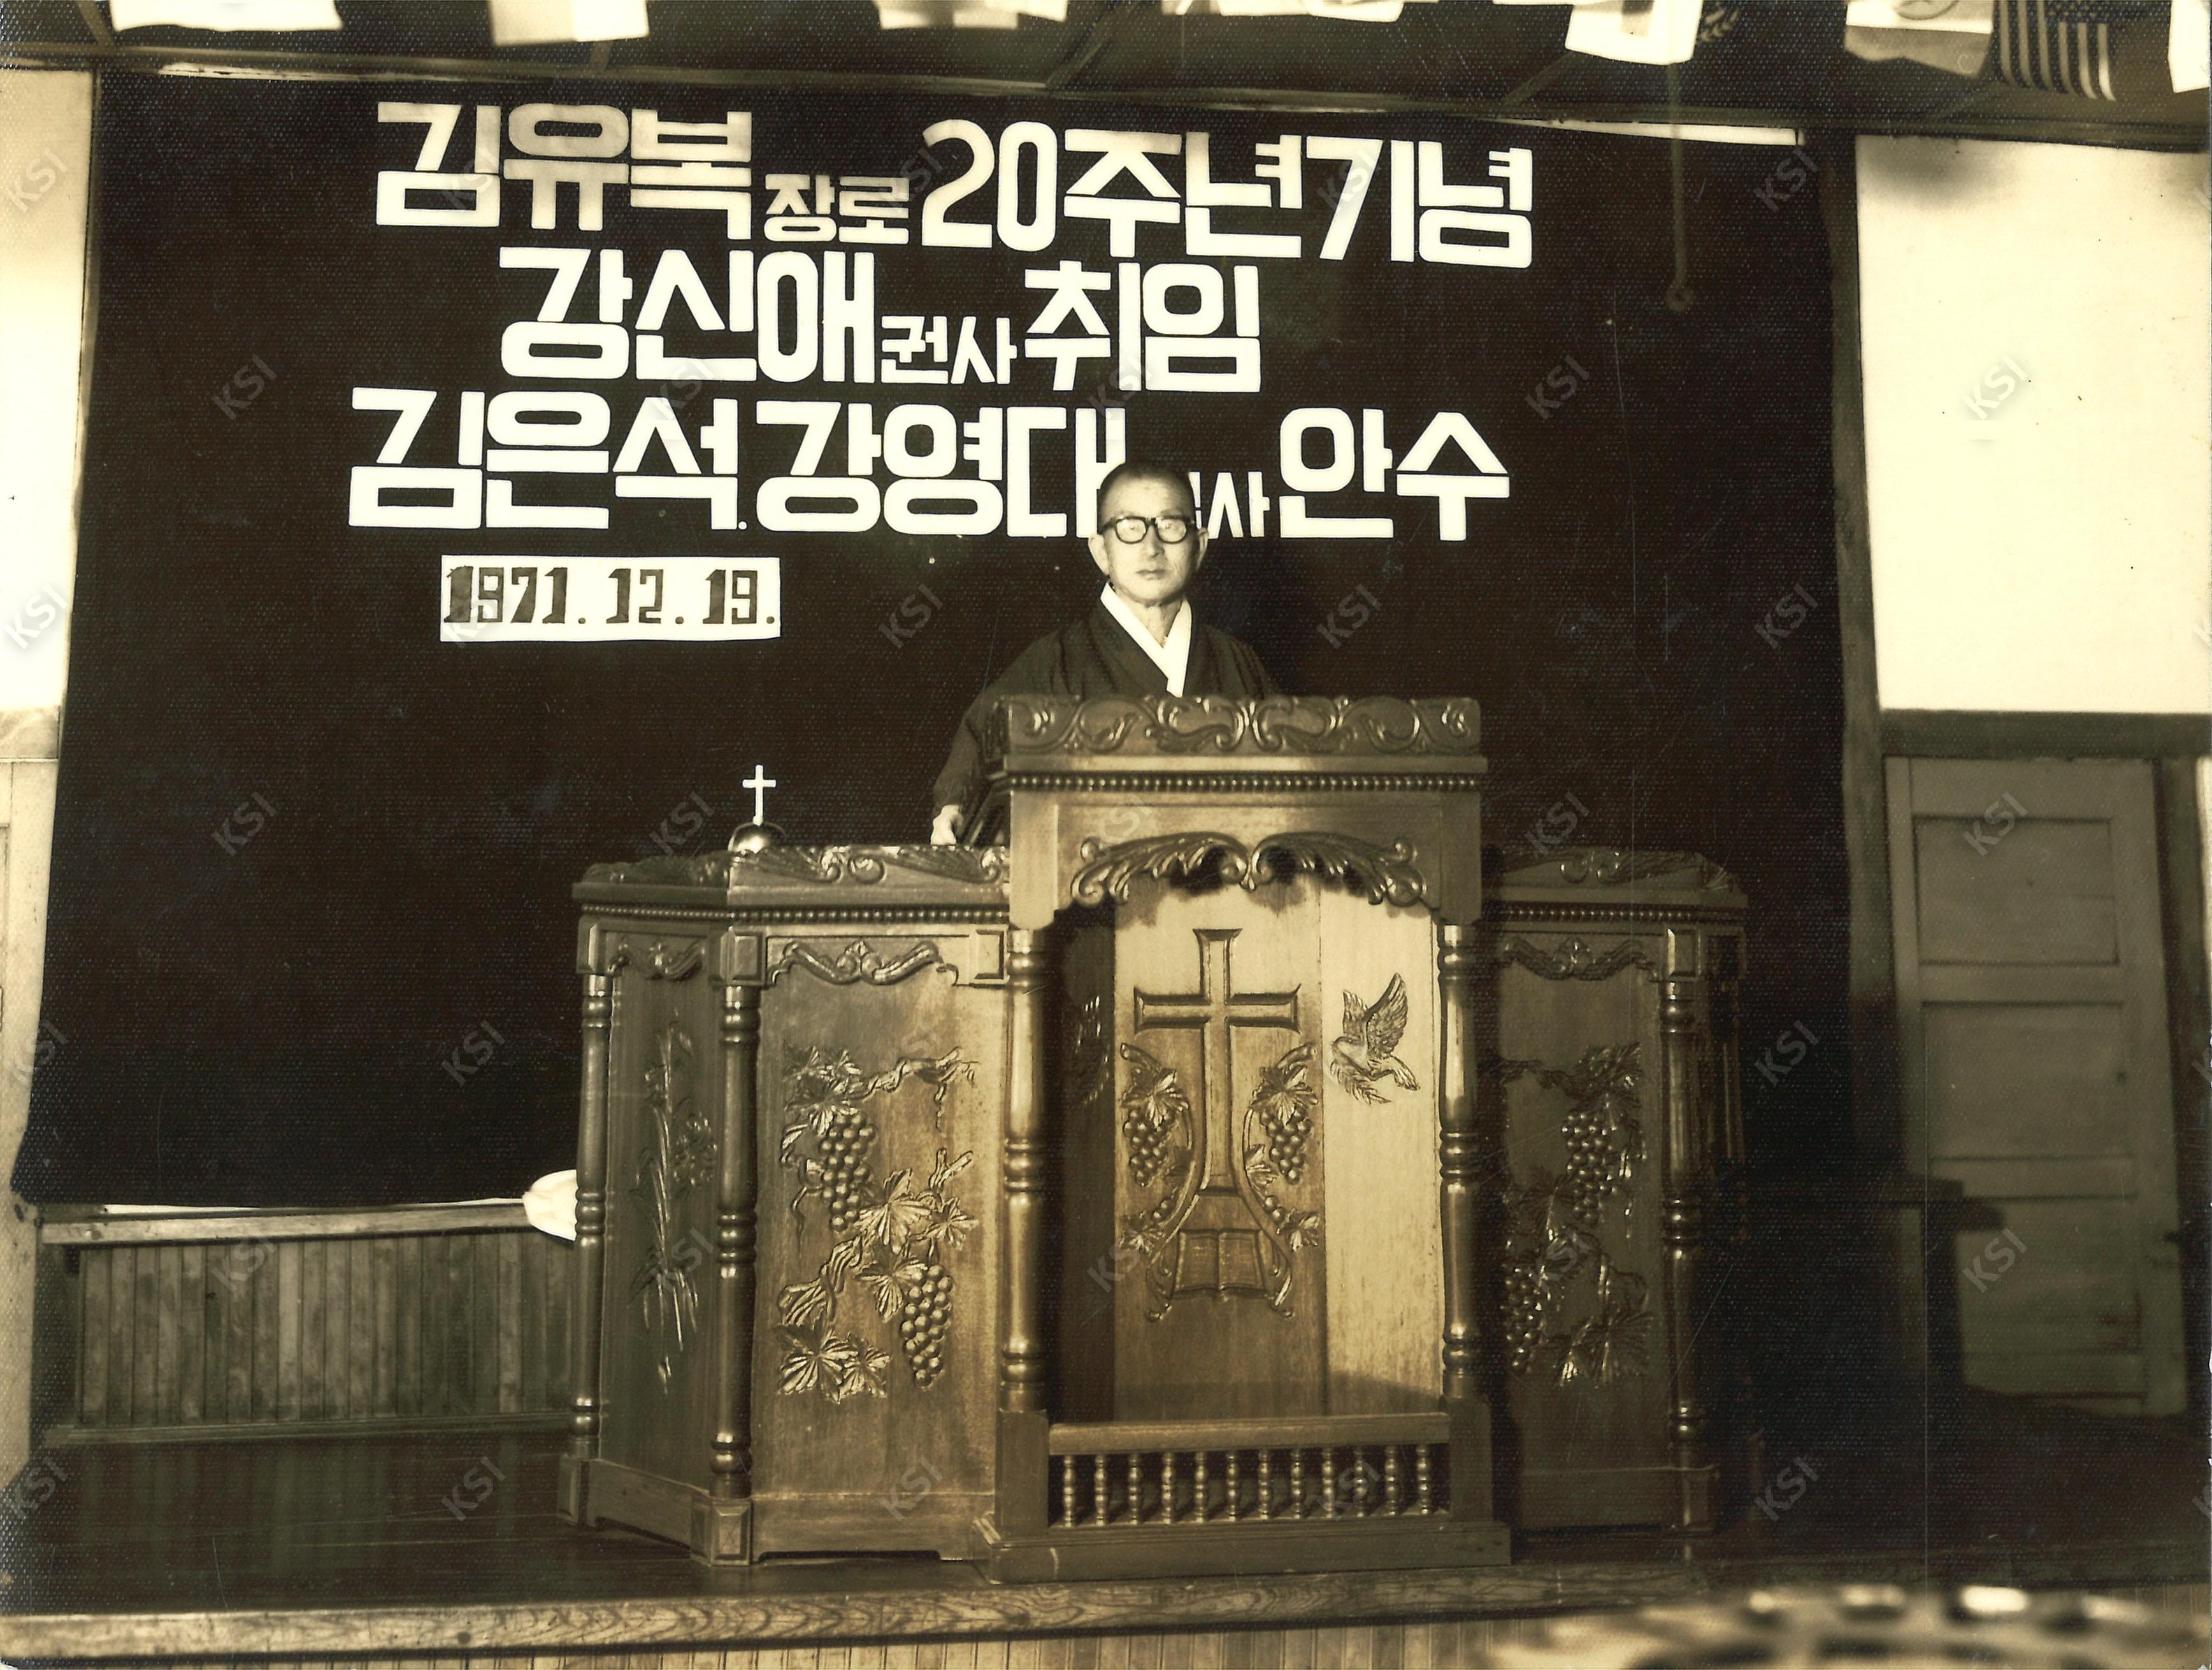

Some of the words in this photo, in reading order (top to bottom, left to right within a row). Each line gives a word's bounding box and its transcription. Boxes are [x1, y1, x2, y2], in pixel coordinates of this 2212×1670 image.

[376, 102, 752, 240] 김유복
[764, 174, 910, 245] 장로
[499, 246, 875, 383] 강신애
[881, 315, 1017, 385] 권사
[1024, 260, 1261, 393] 취임
[1188, 471, 1270, 539] 사
[1279, 408, 1510, 541] 안수
[443, 565, 587, 625] 1971.
[606, 568, 685, 625] 12.
[702, 569, 775, 625] 19.
